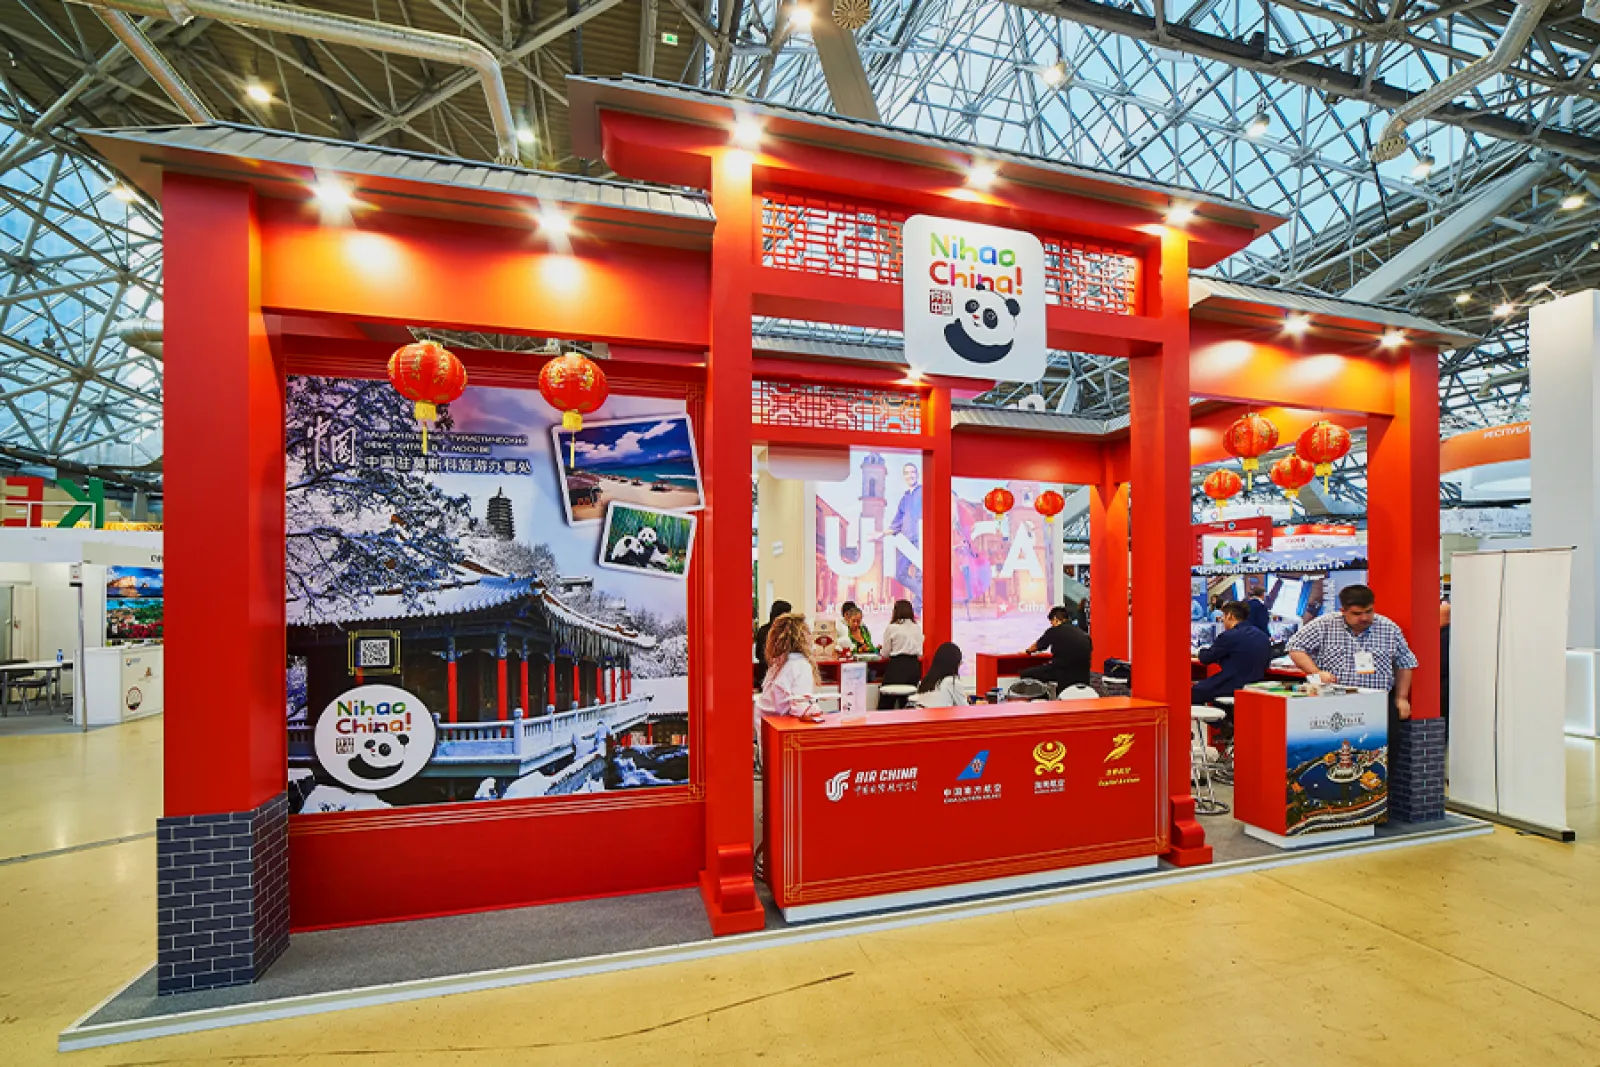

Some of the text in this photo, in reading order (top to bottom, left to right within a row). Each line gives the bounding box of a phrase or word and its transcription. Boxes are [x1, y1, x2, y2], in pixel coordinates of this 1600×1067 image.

[930, 232, 1016, 267] Nihao
[929, 260, 1023, 296] China!
[337, 700, 406, 716] Nihao
[336, 712, 412, 734] China!
[855, 767, 918, 783] AIR CHINA
